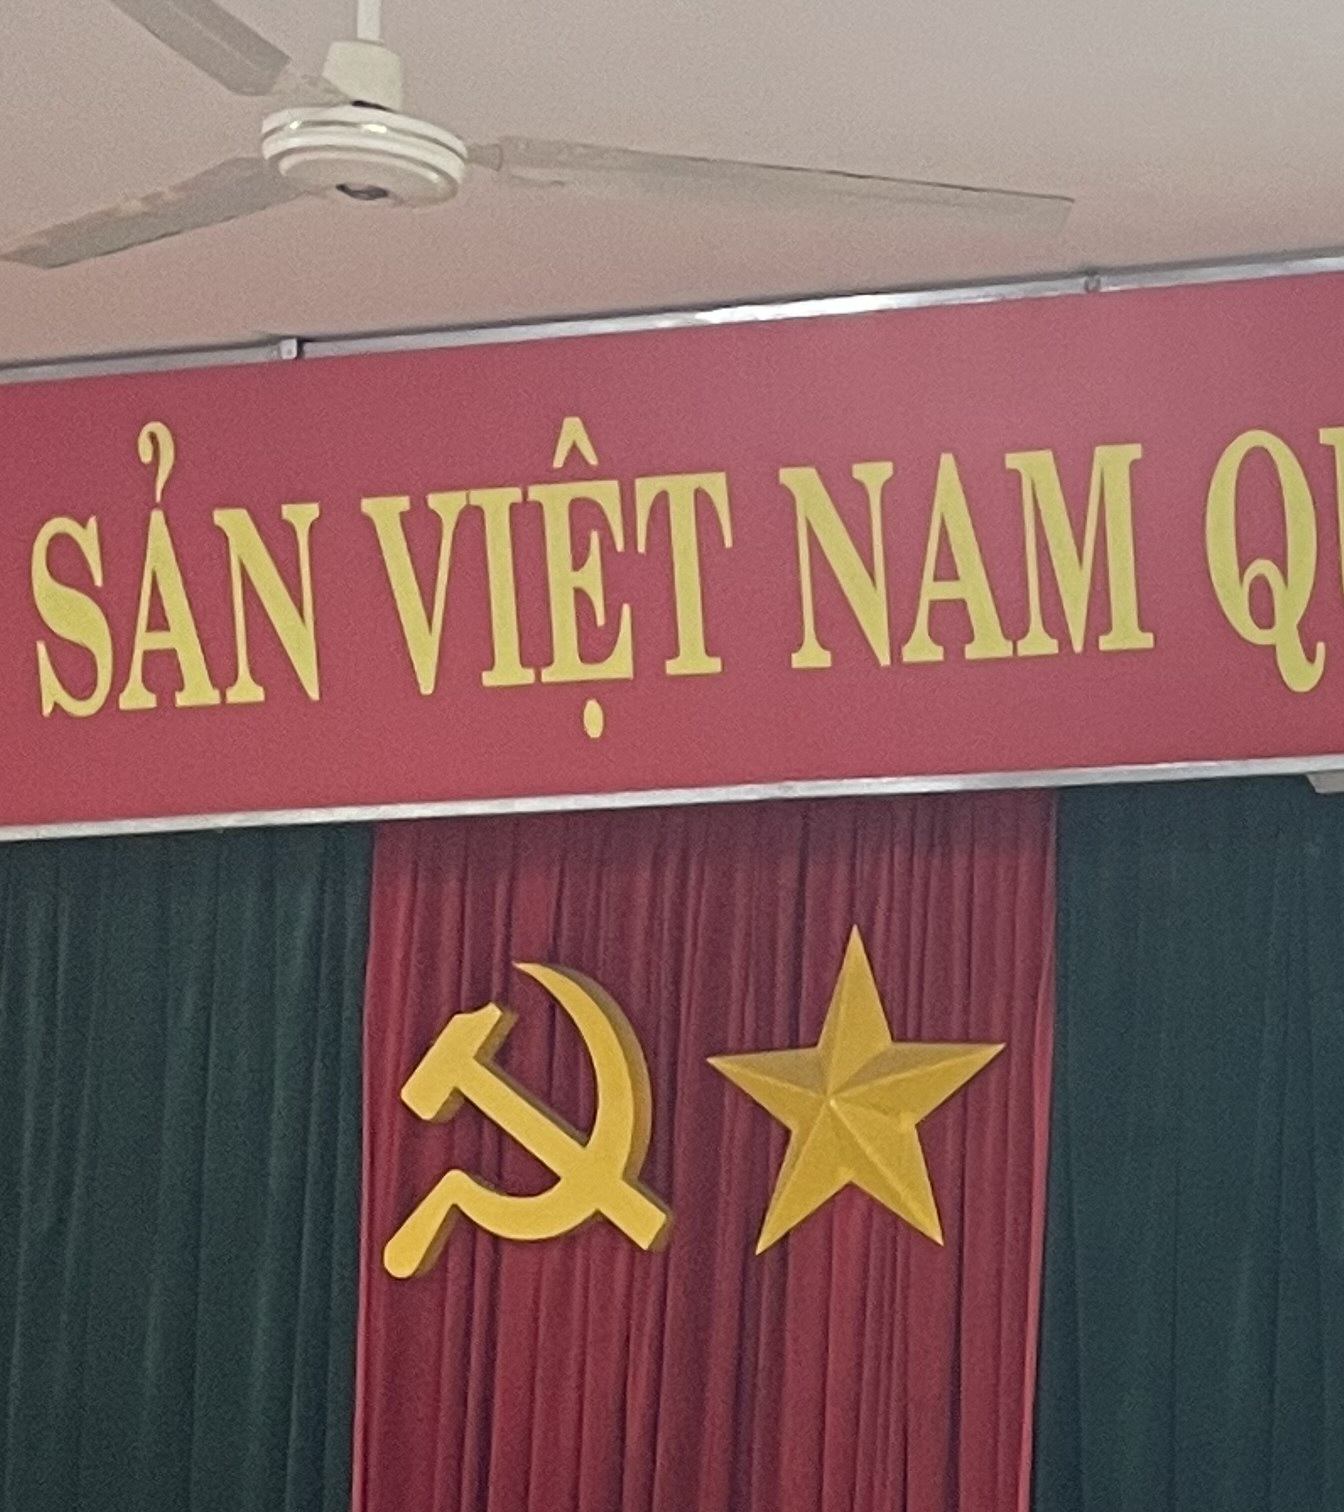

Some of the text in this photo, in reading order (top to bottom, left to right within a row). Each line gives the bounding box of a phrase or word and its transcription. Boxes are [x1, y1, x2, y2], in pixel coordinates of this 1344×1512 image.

[31, 421, 320, 717] SẢN
[362, 416, 732, 738] VIỆT
[779, 443, 1154, 669] NAM
